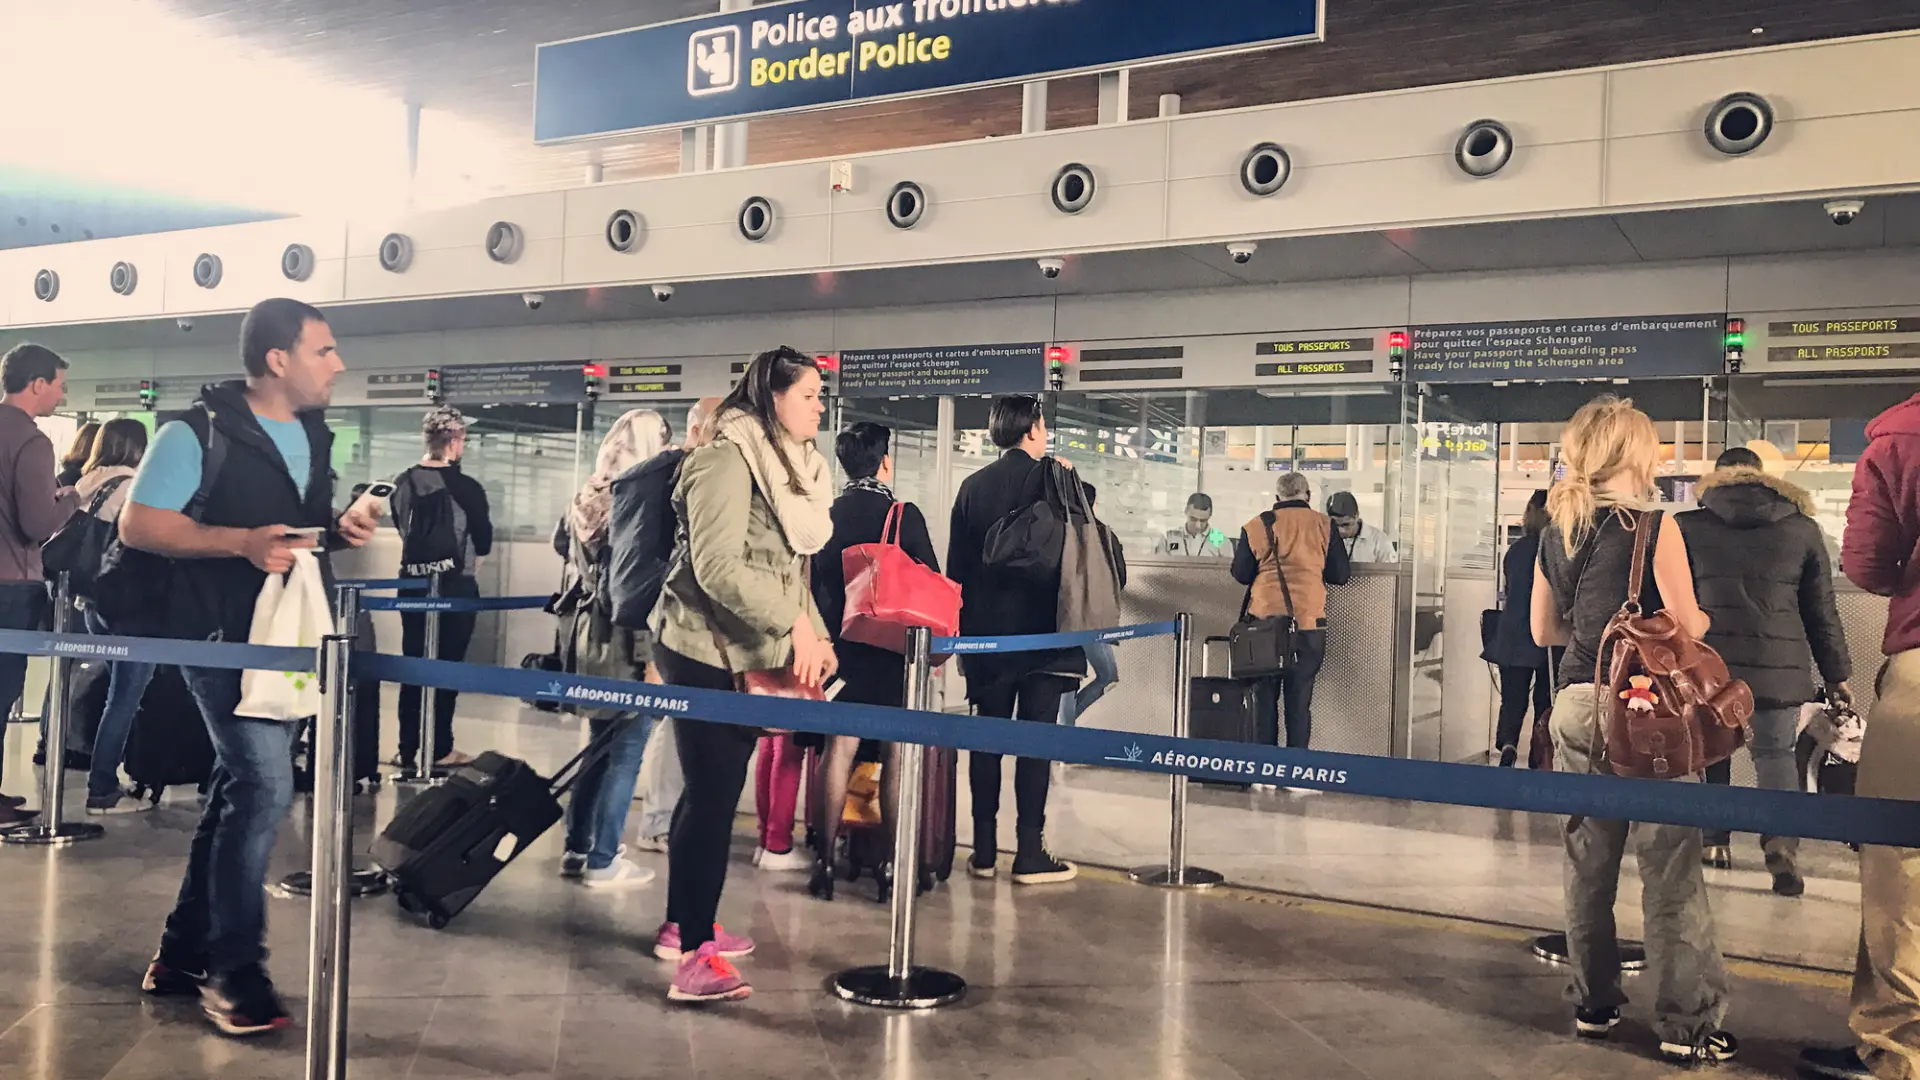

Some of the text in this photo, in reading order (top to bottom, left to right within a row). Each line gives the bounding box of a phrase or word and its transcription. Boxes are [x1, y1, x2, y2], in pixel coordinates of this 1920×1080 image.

[751, 13, 838, 49] Police
[847, 3, 904, 34] aux
[750, 31, 951, 86] Border Police
[1414, 319, 1718, 339] Préparez vos passeports et cartes d'embarquement
[1792, 320, 1897, 333] TOUS PASSEPORTS
[1273, 341, 1351, 352] TOUS PASSEPORTS
[1413, 335, 1592, 351] pour quitter l'espace Schengen
[843, 353, 875, 362] Préparez
[892, 351, 933, 360] passeports
[945, 349, 969, 357] cartes
[971, 347, 1041, 357] d'embarquement
[1414, 345, 1637, 361] Have your passport and boarding pass
[1798, 346, 1889, 358] ALL PASSPORTS
[842, 358, 960, 371] pour quitter l'espace Schengen
[1277, 363, 1344, 373] ALL PASSPORTS
[1413, 357, 1624, 372] ready for leaving the Schengen area
[862, 371, 880, 379] your
[881, 369, 915, 378] passport
[917, 368, 932, 376] and
[933, 367, 969, 377] boarding
[971, 367, 989, 376] pass
[842, 376, 981, 388] ready for leaving the Schengen area
[54, 641, 129, 656] AÉROPORTS DE PARIS
[565, 685, 689, 712] AÉROPORTS DE PARIS
[1150, 749, 1347, 784] AÉROPORTS DE PARIS
